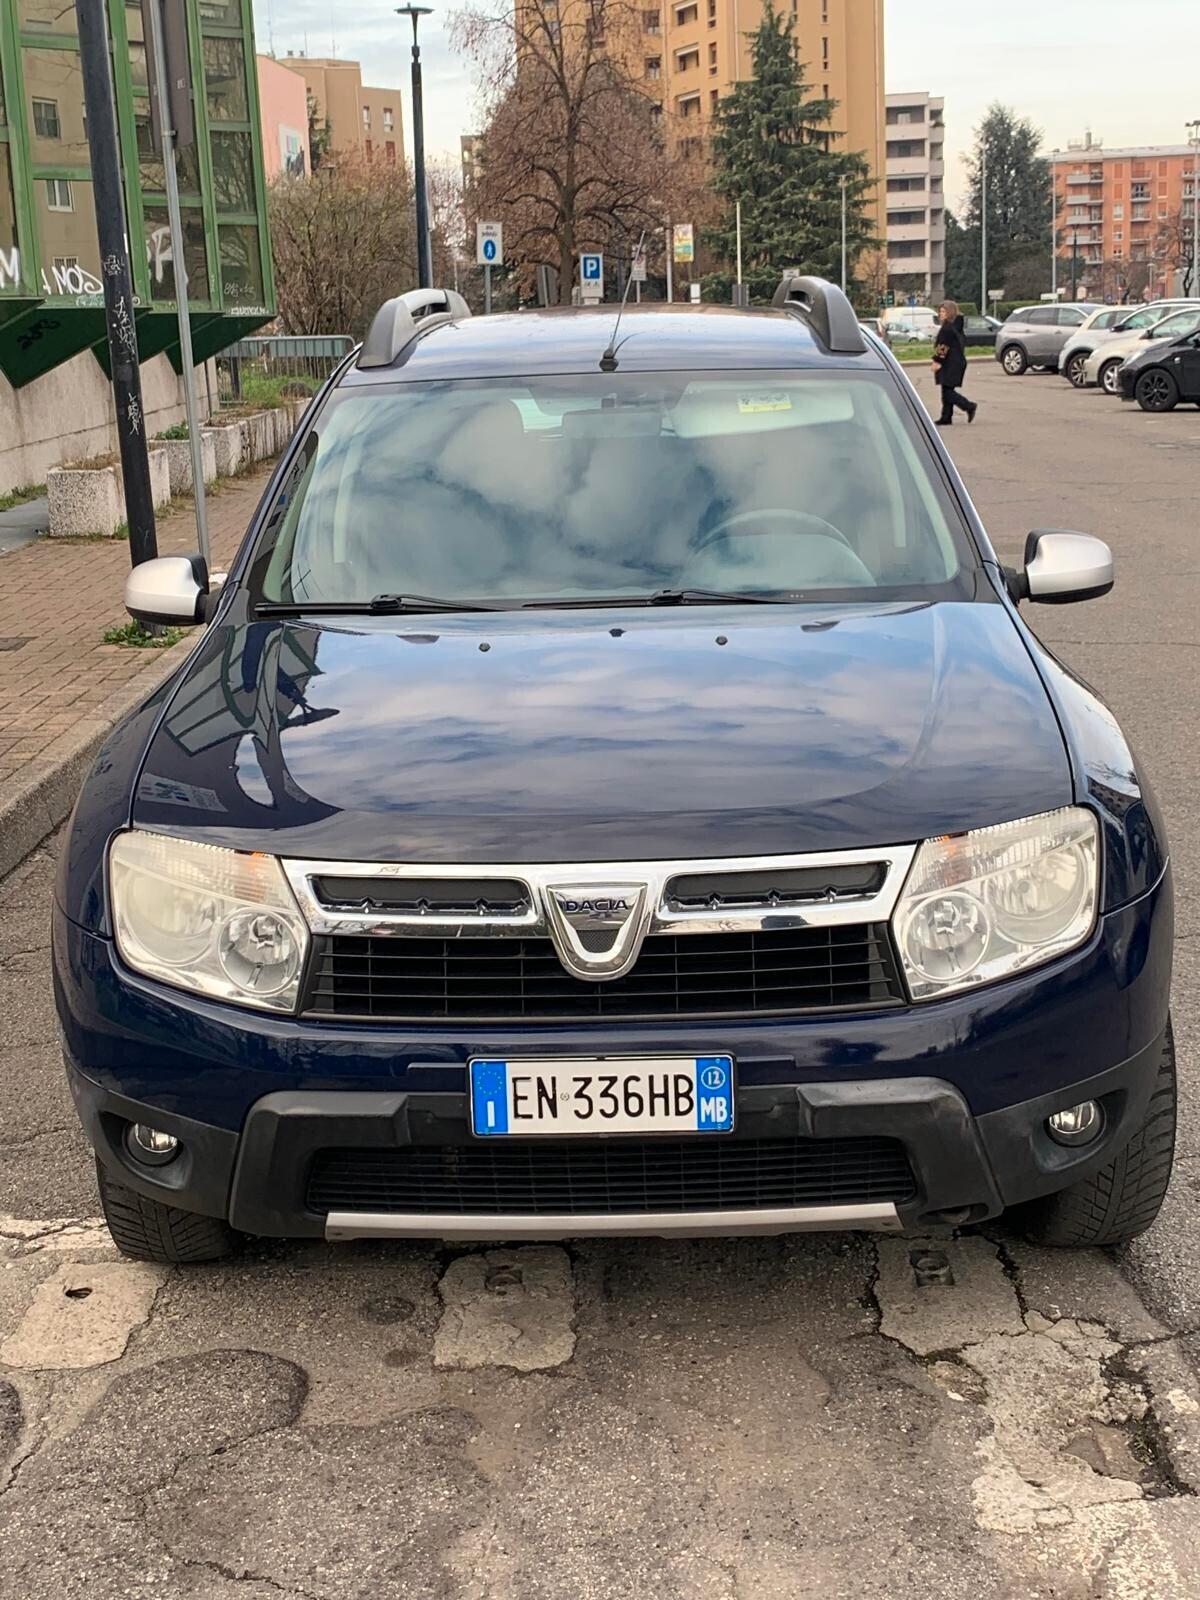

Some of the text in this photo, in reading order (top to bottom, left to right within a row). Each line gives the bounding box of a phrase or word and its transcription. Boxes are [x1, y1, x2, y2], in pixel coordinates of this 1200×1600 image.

[586, 259, 597, 277] P
[565, 899, 628, 912] DACIA
[707, 1070, 720, 1085] 12
[512, 1074, 694, 1119] EN 336HB
[487, 1101, 495, 1127] I
[700, 1096, 727, 1123] MB
